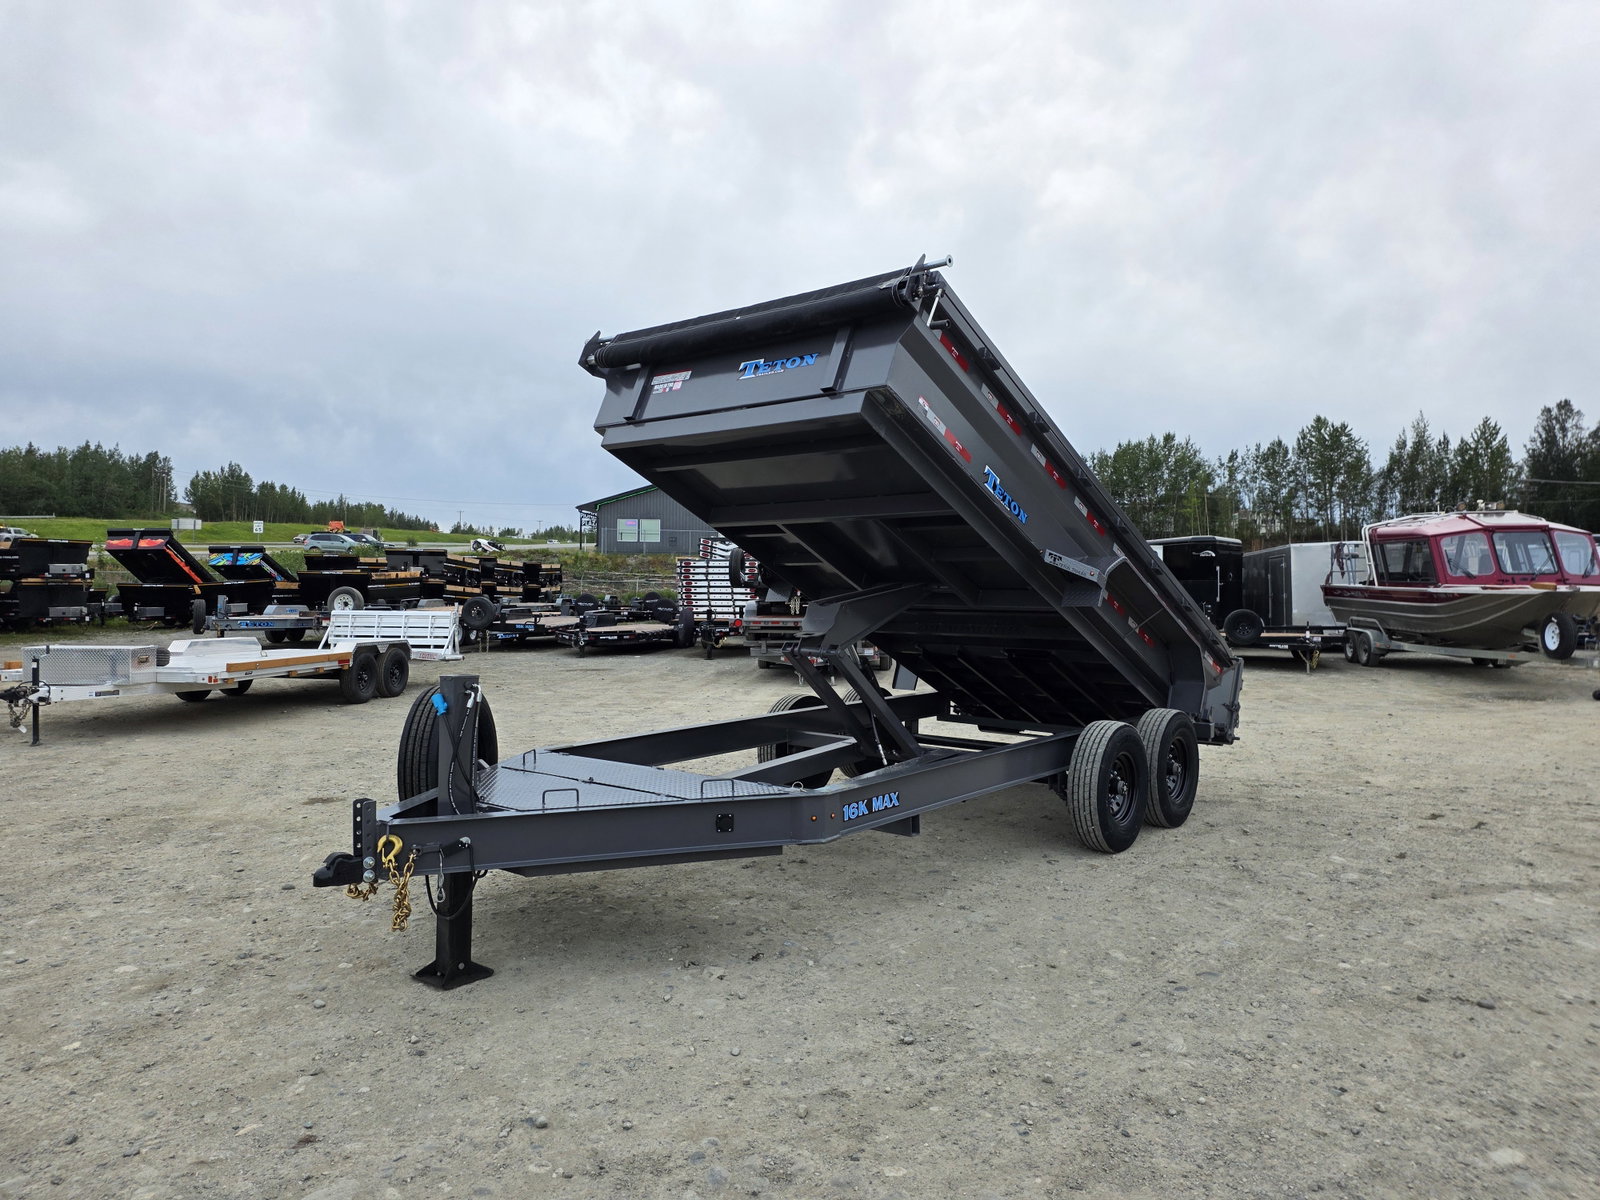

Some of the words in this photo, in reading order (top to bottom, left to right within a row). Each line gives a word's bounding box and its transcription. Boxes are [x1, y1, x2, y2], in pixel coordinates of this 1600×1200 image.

[739, 353, 819, 379] TETON
[984, 465, 1028, 524] TETON
[843, 800, 869, 821] 16K
[872, 791, 900, 812] MAX
